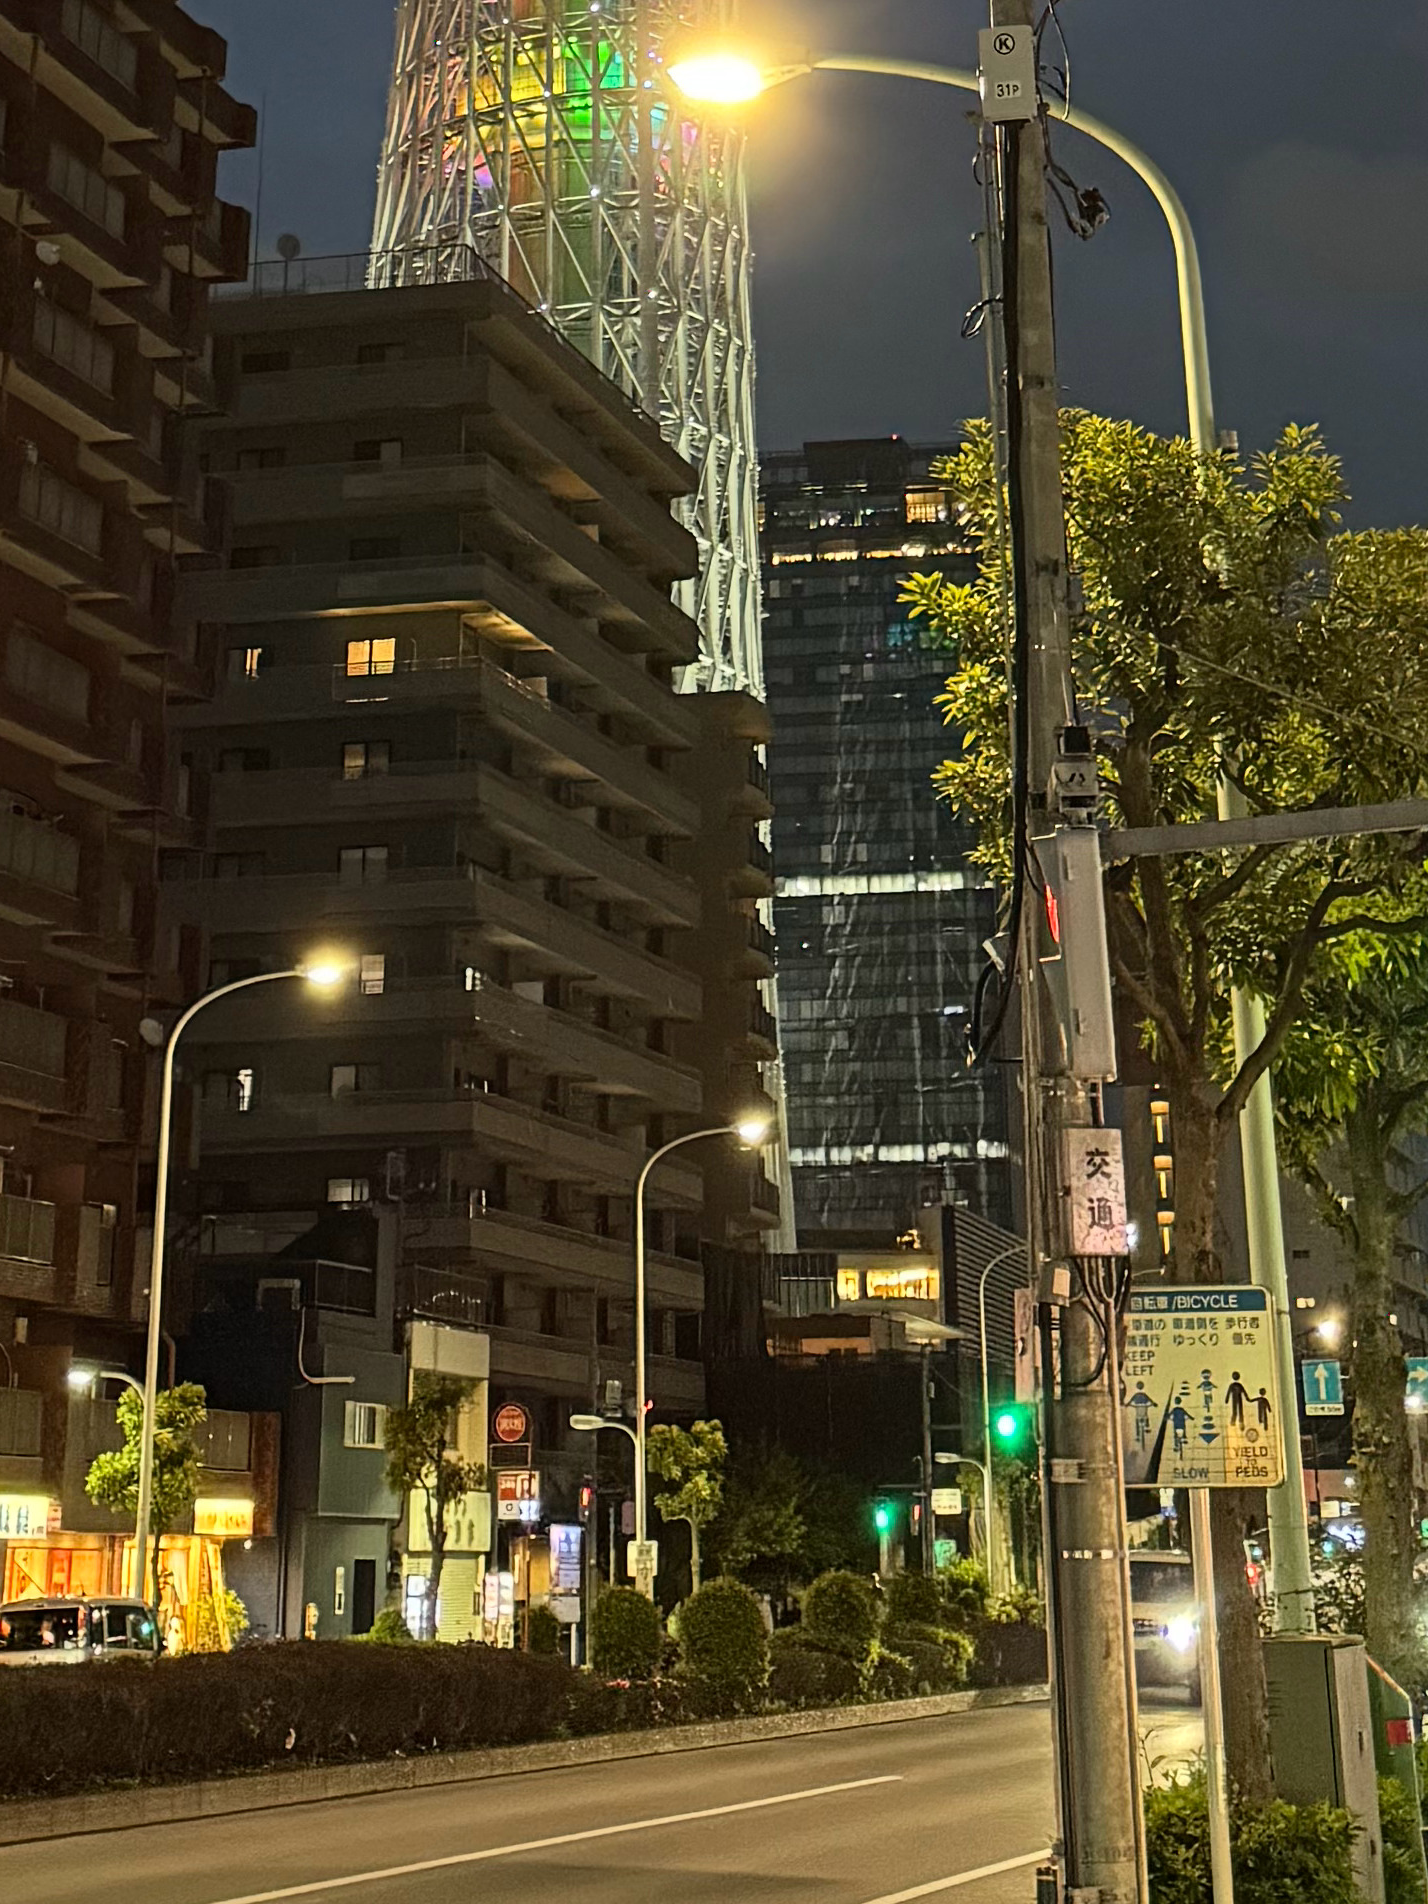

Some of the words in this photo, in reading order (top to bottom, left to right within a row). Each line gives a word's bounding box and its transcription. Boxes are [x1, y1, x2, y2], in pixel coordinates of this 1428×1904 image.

[996, 84, 1020, 97] 31P
[1085, 1147, 1115, 1231] 交通
[1225, 1316, 1260, 1330] 歩行者
[1172, 1334, 1219, 1346] ゆっくり
[1233, 1333, 1256, 1345] 優先
[1125, 1350, 1155, 1361] KEEP
[1125, 1365, 1154, 1376] LEFT
[1232, 1446, 1268, 1457] YIELD
[1173, 1467, 1209, 1479] SLOW
[1235, 1466, 1269, 1478] PEDS
